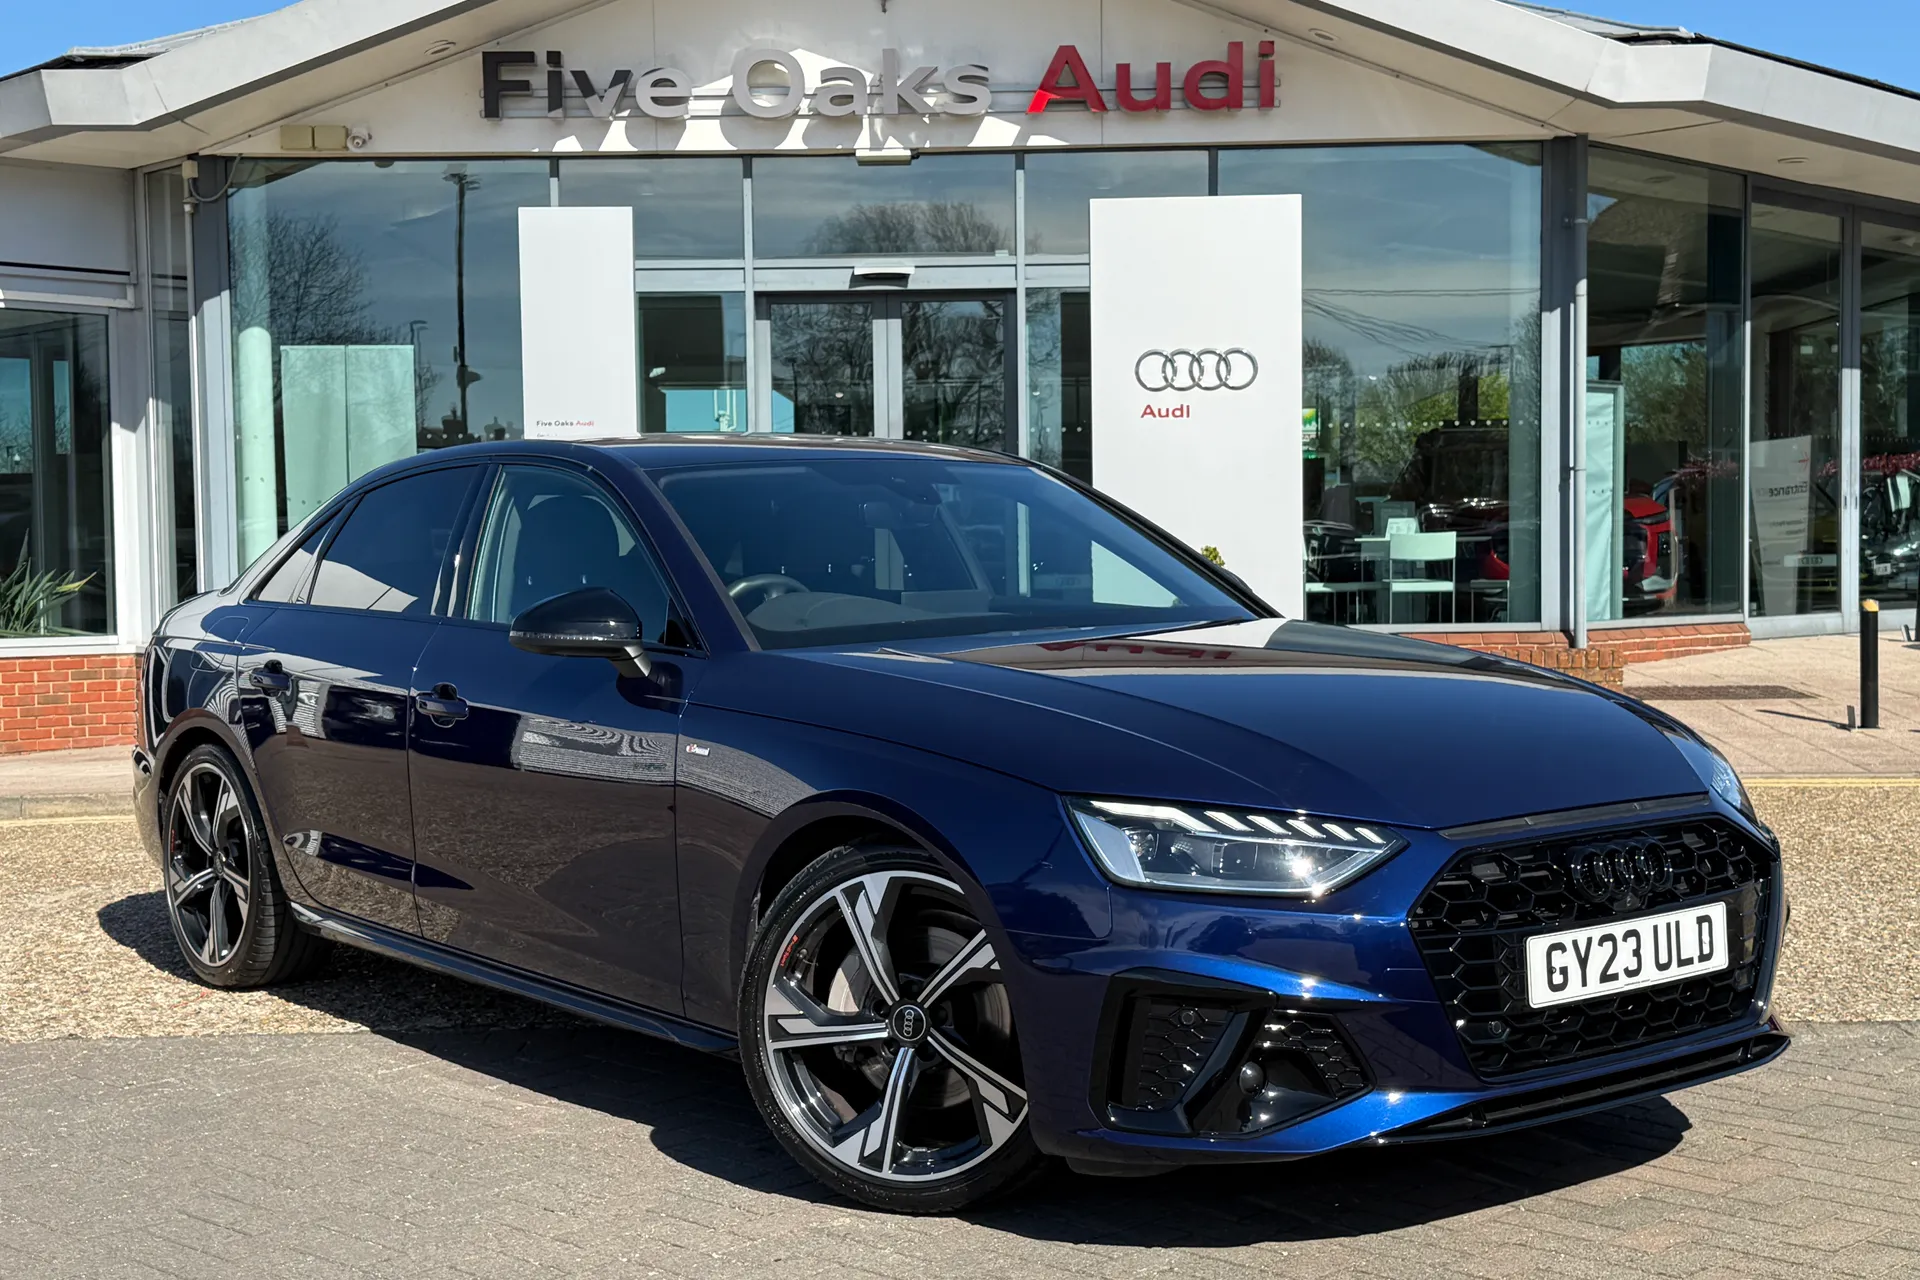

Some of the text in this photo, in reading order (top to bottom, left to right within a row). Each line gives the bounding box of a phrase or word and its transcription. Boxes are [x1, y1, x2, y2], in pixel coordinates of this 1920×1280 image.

[482, 41, 1275, 119] Five Oaks Audi
[1141, 404, 1190, 418] Audi
[1546, 914, 1714, 993] GY23 ULD
